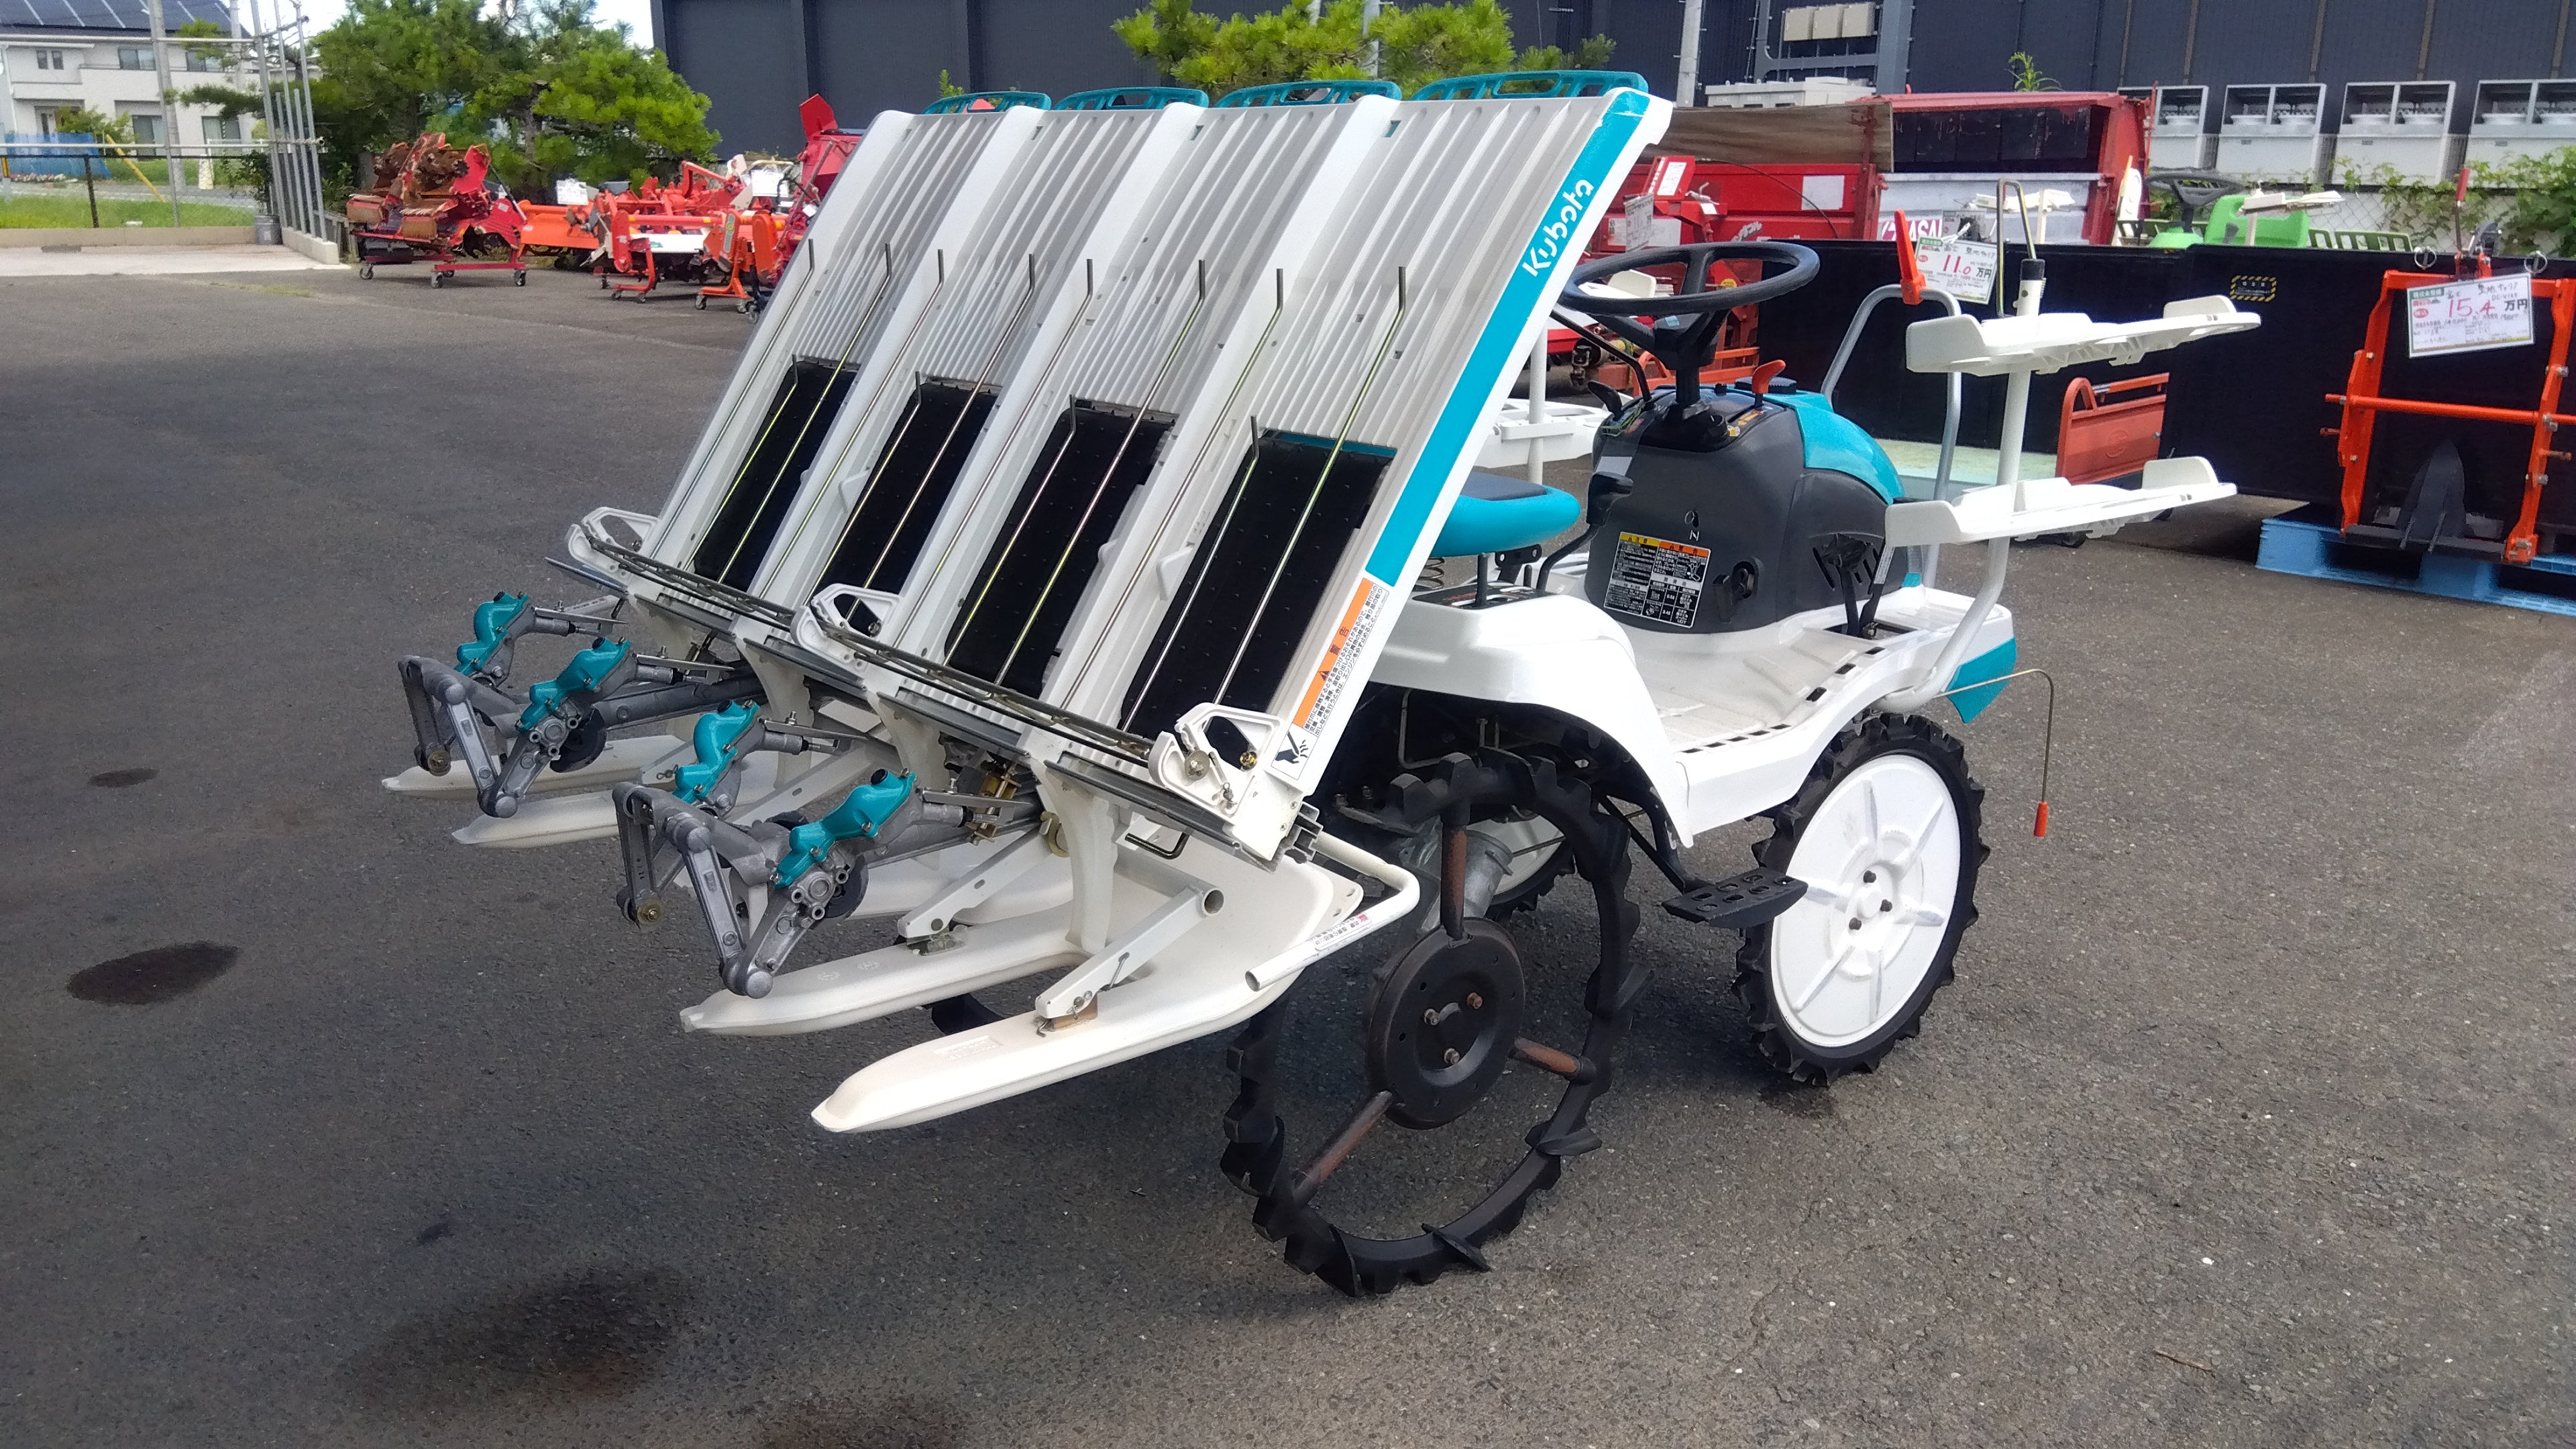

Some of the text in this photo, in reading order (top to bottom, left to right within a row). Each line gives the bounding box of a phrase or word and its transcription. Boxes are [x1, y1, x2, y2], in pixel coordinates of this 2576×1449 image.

[1522, 179, 1594, 277] Kubota
[1976, 267, 1992, 279] 万円
[2504, 299, 2528, 311] 万円
